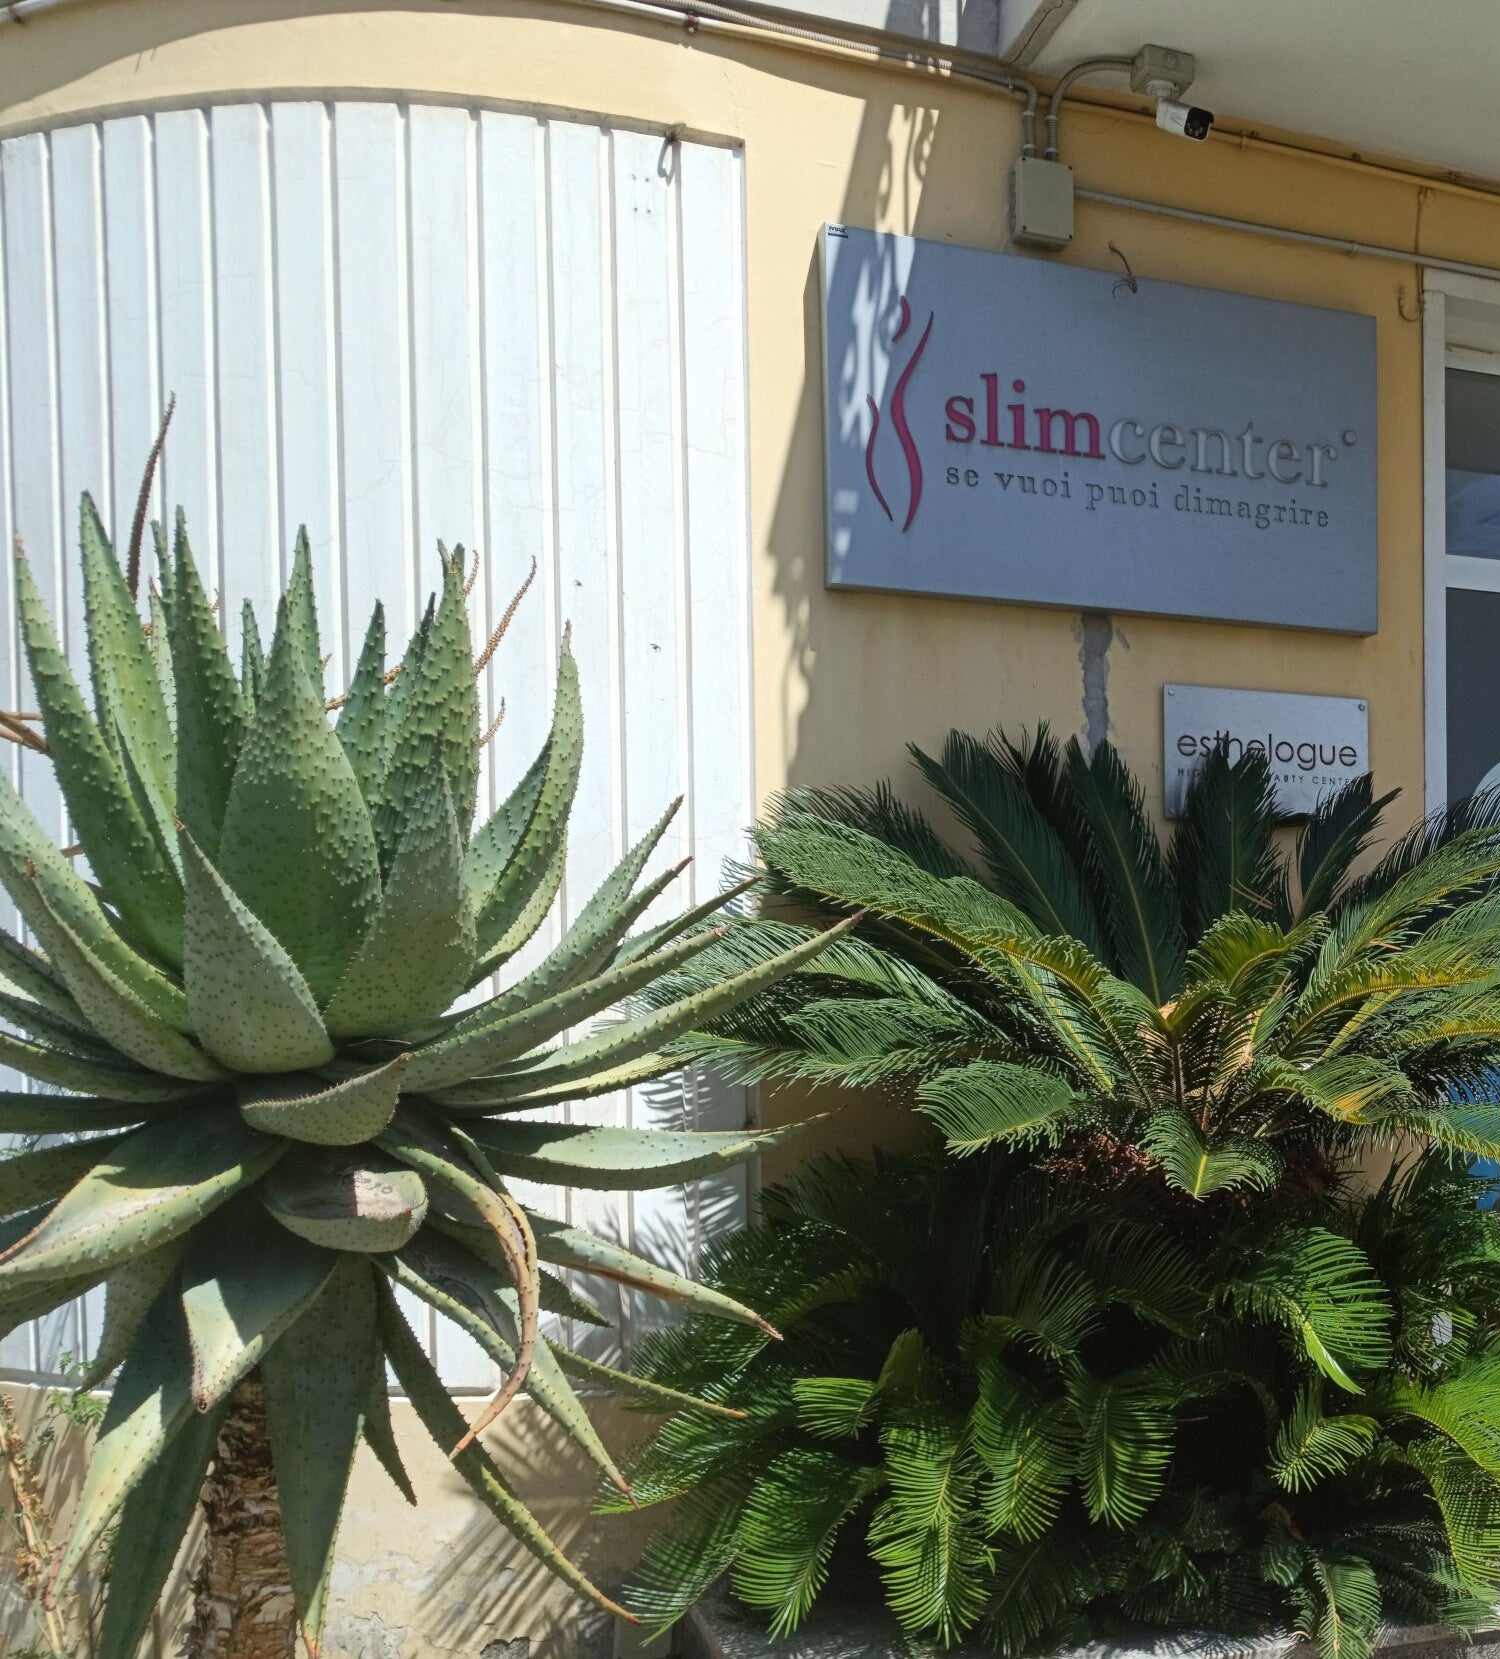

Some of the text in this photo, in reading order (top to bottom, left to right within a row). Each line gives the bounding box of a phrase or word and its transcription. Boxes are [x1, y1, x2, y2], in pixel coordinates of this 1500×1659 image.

[946, 465, 1329, 530] se vuoi puoi dimagrire
